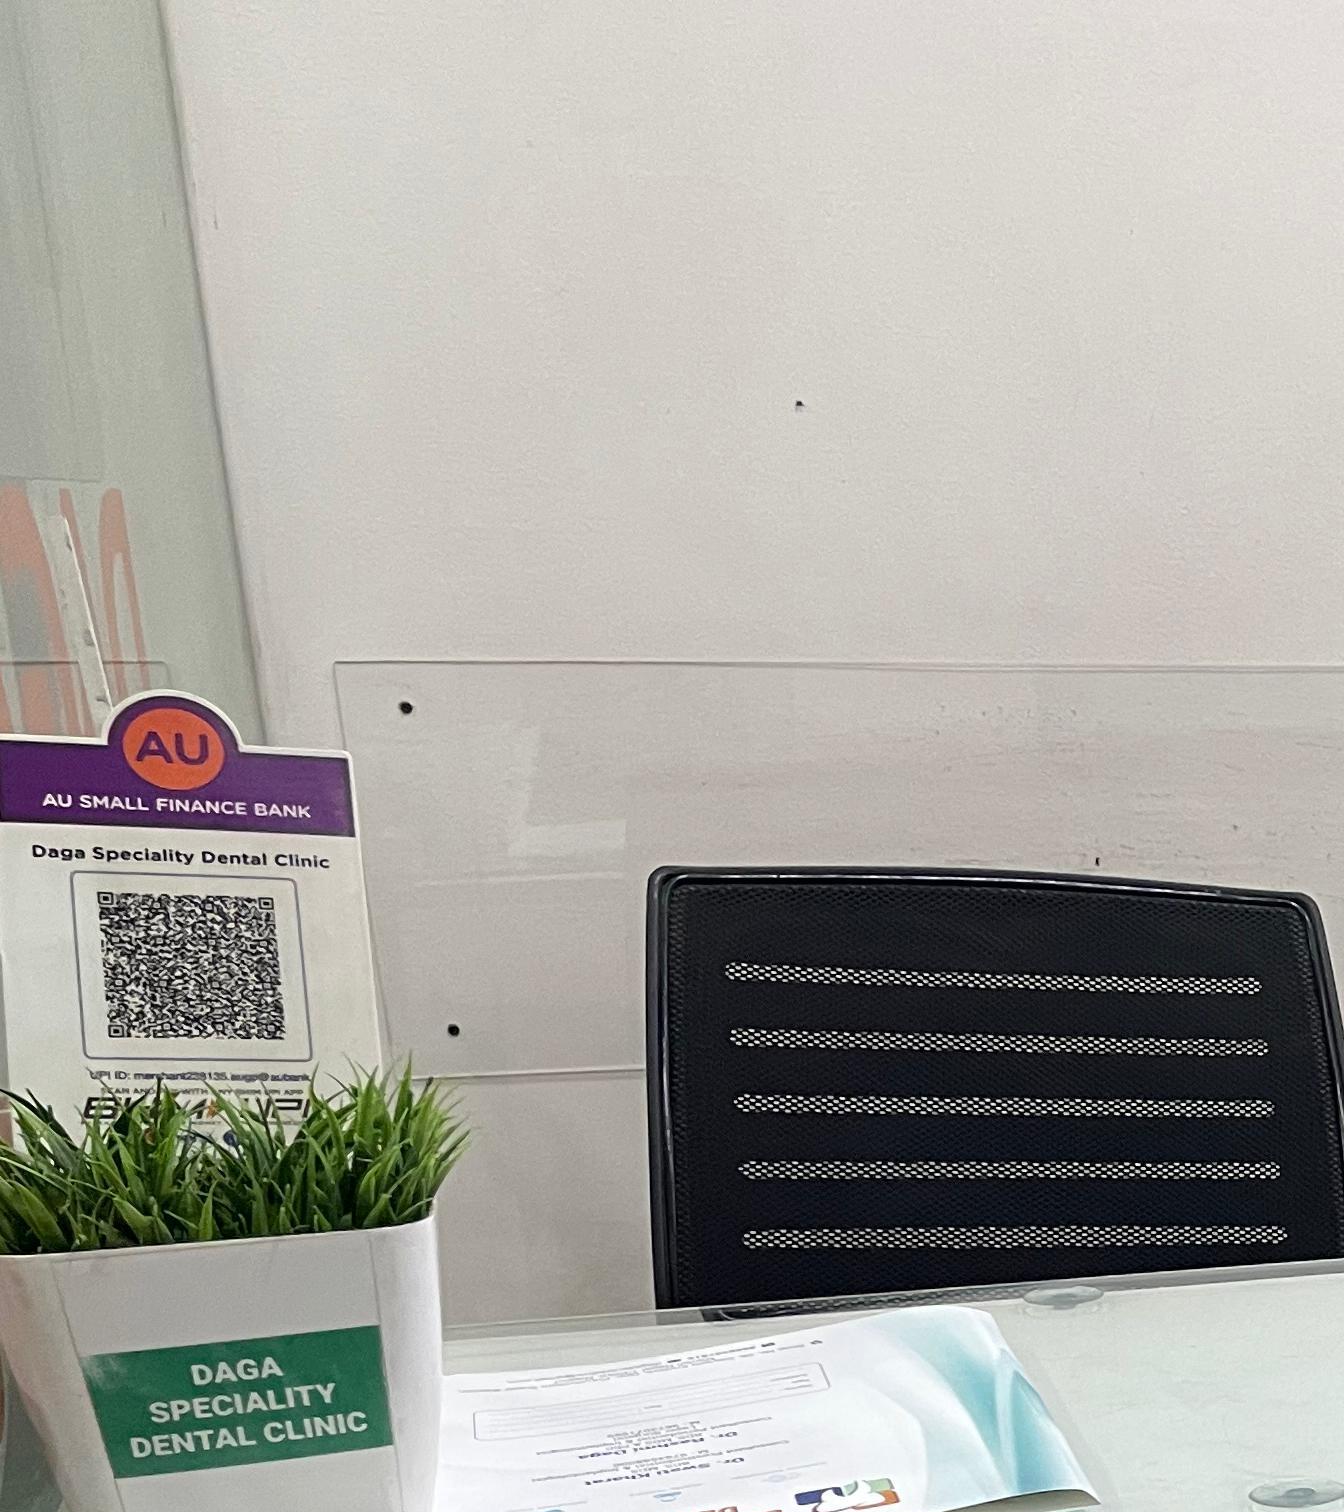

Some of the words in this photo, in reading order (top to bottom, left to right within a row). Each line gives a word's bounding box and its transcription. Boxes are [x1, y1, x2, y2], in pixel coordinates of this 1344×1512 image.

[136, 731, 210, 765] AU
[42, 793, 73, 808] AU
[79, 794, 150, 812] SMALL
[156, 798, 248, 816] FINANCE
[254, 803, 312, 820] BANK
[31, 845, 86, 861] Daga
[92, 846, 195, 866] Speciality
[201, 851, 268, 866] Dental
[274, 854, 331, 869] Clinic
[190, 1356, 285, 1386] DAGA
[150, 1382, 336, 1424] SPECIALITY
[129, 1425, 257, 1459] DENTAL
[263, 1410, 368, 1443] CLINIC
